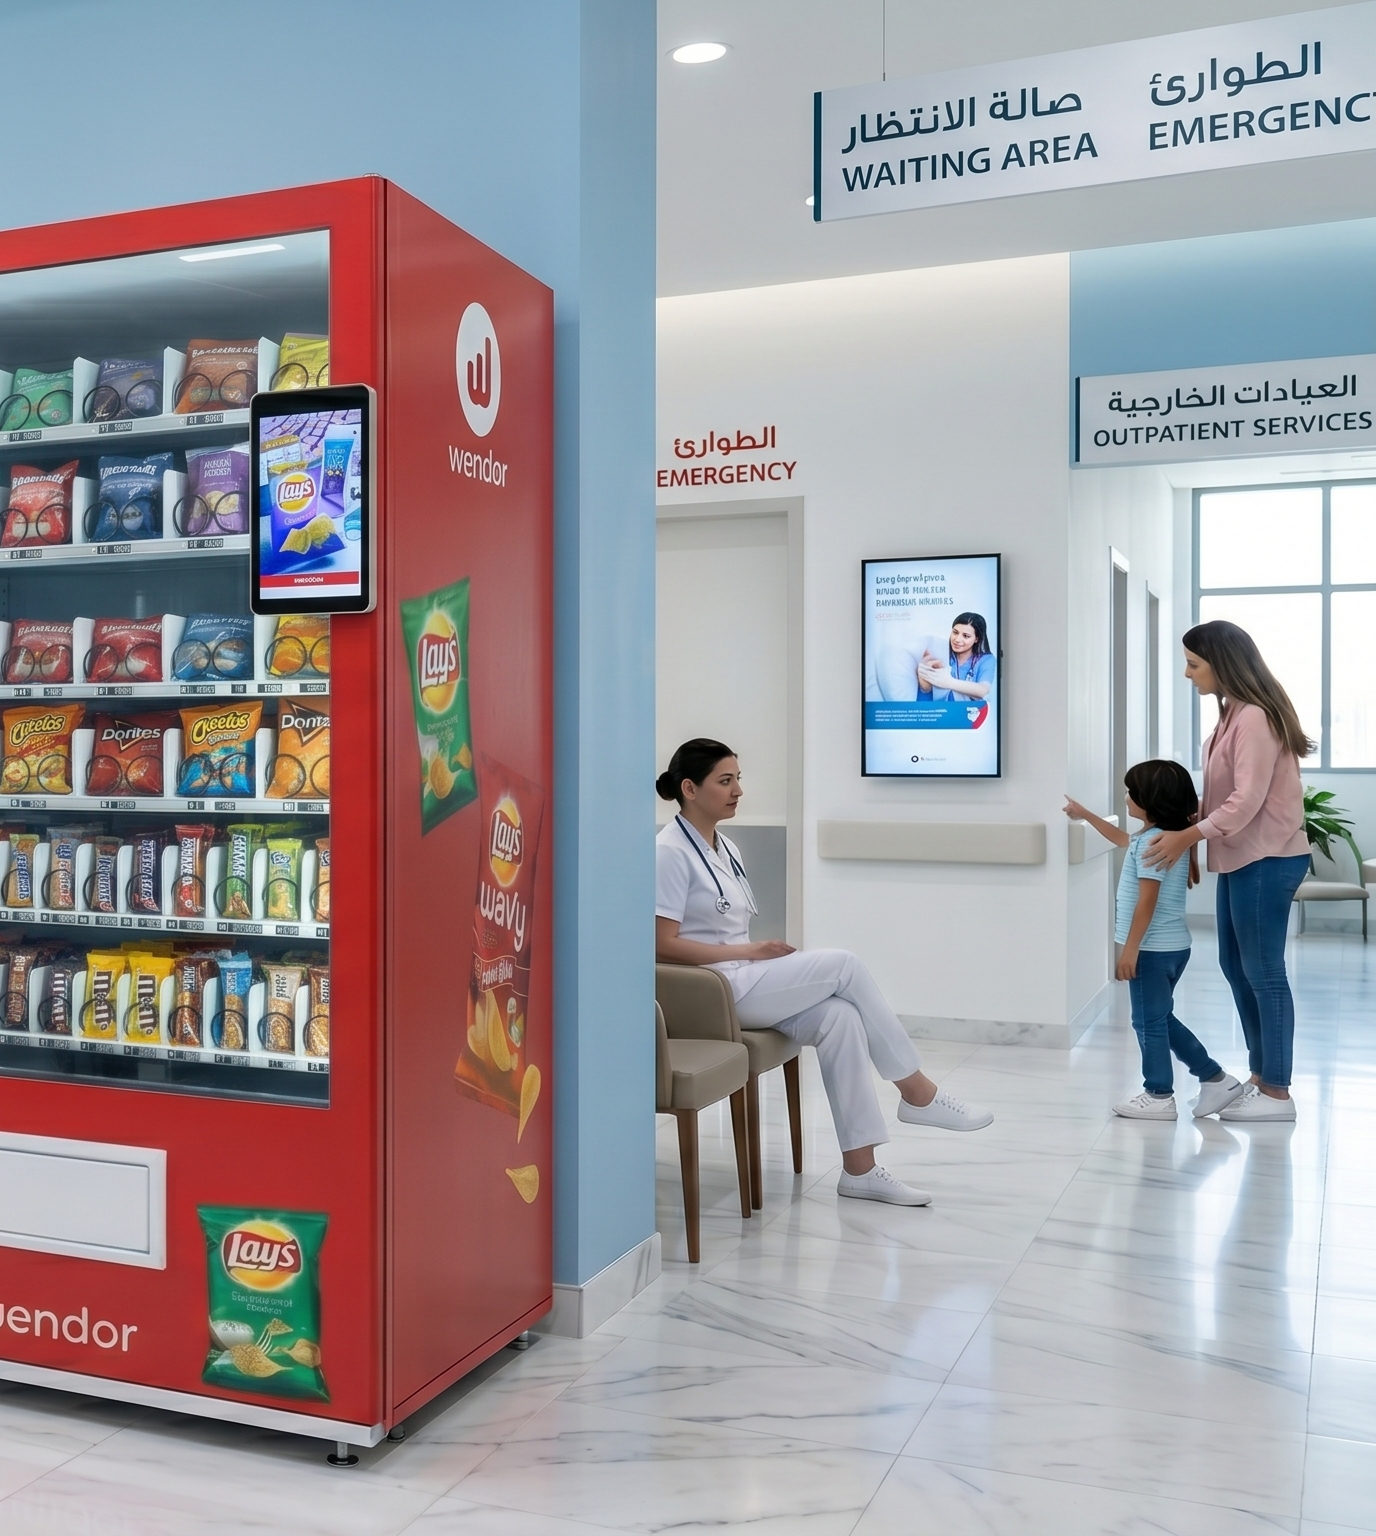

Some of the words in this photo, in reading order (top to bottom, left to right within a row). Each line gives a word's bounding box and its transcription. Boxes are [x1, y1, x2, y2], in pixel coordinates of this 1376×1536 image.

[1150, 42, 1322, 108] الطوارئ
[841, 95, 977, 154] الانتظار
[988, 87, 1084, 123] صالة
[1149, 92, 1376, 151] EMERGENC
[841, 148, 992, 193] WAITING
[1001, 132, 1099, 171] AREA
[1108, 385, 1226, 418] الخارجية
[1233, 375, 1357, 407] العيادات
[673, 425, 777, 460] الطوارئ
[1093, 418, 1246, 449] OUTPATIENT
[1252, 411, 1373, 438] SERVICES
[448, 444, 508, 488] wendor
[656, 461, 797, 488] EMERGENCY
[479, 881, 527, 953] wavy
